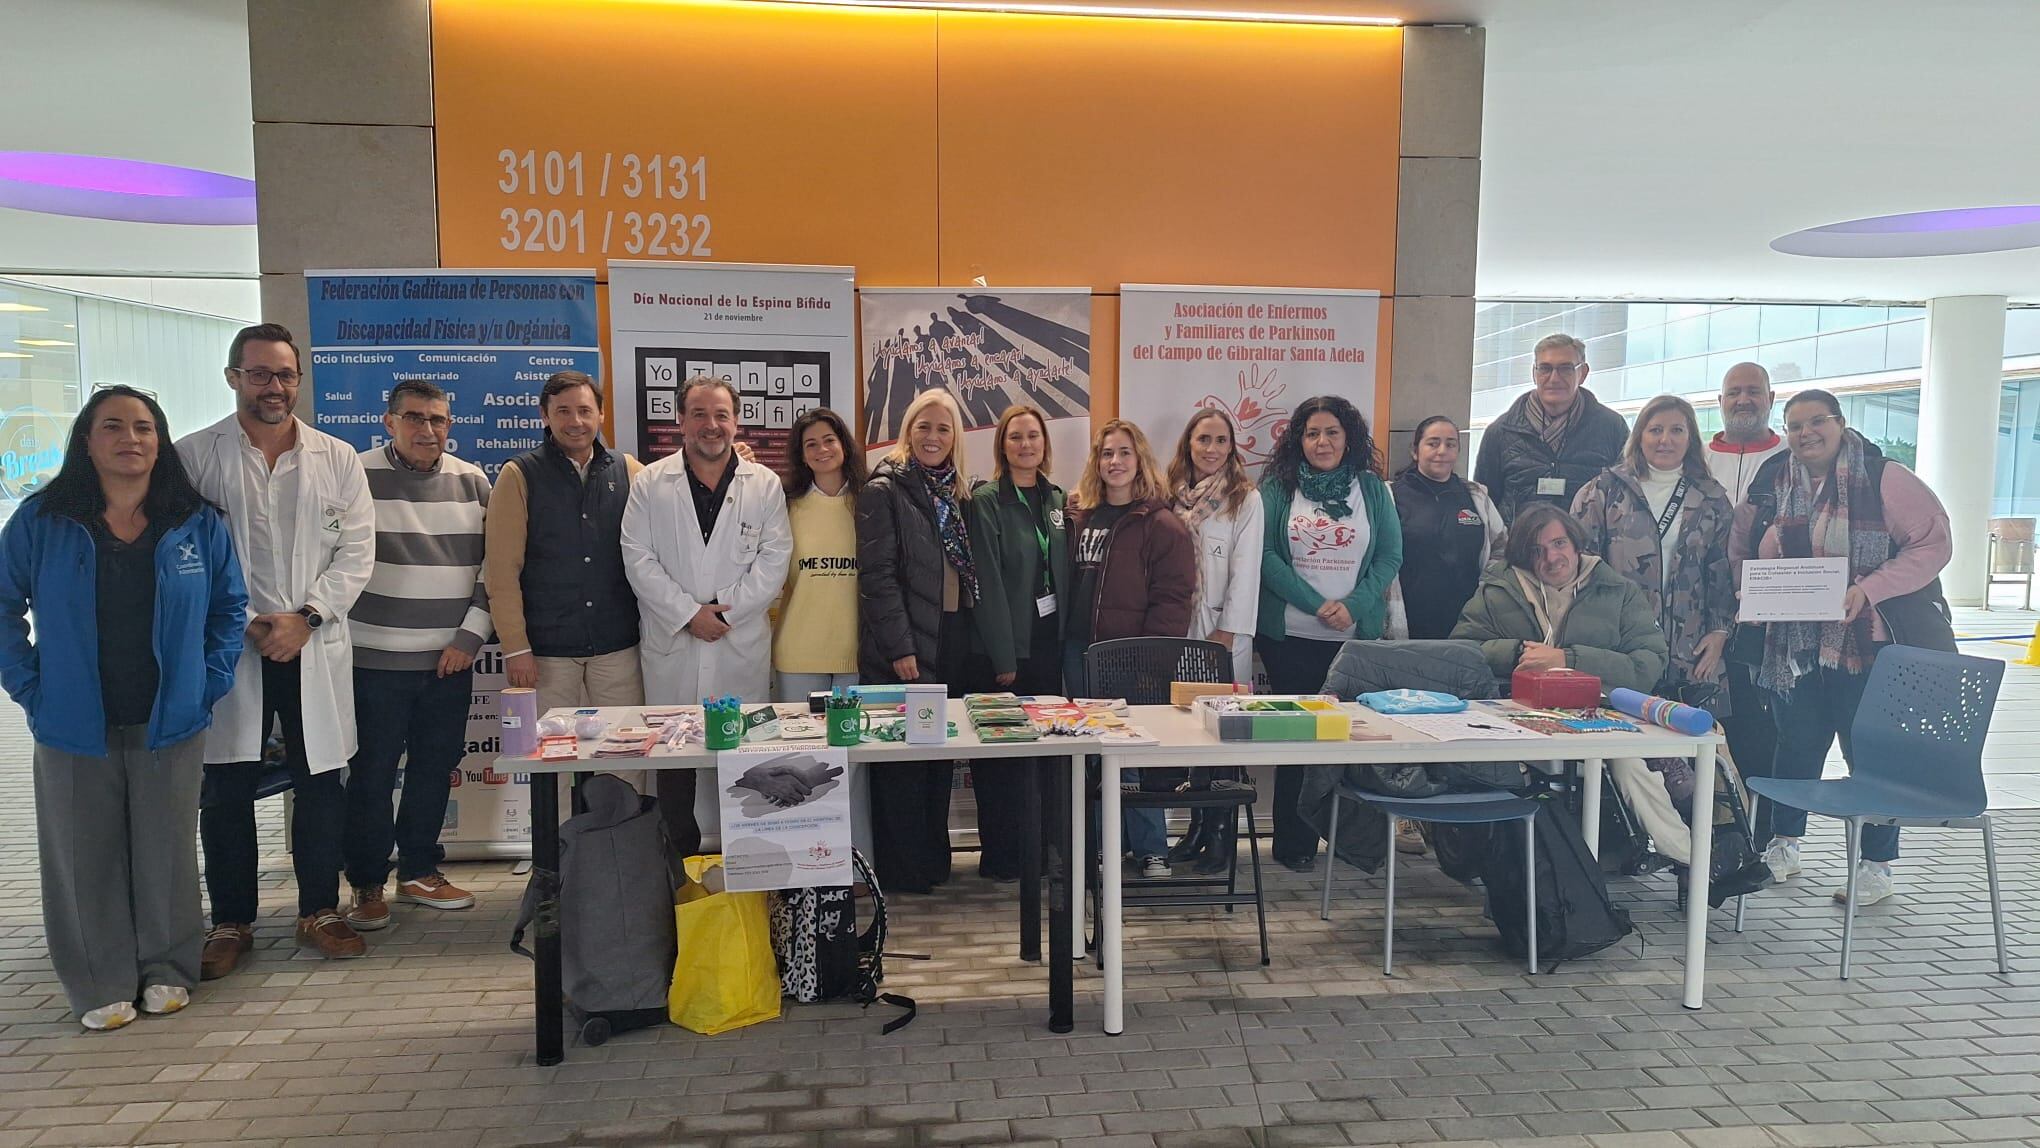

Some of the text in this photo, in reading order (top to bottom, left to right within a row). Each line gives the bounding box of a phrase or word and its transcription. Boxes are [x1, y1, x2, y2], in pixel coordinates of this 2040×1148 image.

[498, 149, 706, 200] 3101 / 3131
[500, 208, 712, 256] 3201 / 3232
[321, 277, 585, 300] Federación Gaditana de Personas con
[634, 292, 831, 310] Día Nacional de la Espina Bífida
[704, 312, 764, 322] 21 de noviembre
[1174, 302, 1328, 320] Asociación de Enfermos
[337, 317, 571, 345] Discapacidad Física y/u Orgánica
[1165, 324, 1335, 341] y Familiares de Parkinson
[313, 353, 394, 364] Ocio Inclusivo
[418, 352, 496, 362] Comunicación
[528, 356, 574, 366] Centros
[1133, 344, 1364, 363] del Campo de Gibraltar Santa Adela
[393, 372, 460, 380] Voluntariado
[514, 372, 551, 380] Asiste
[650, 364, 672, 381] Yo
[325, 392, 352, 400] Salud
[484, 392, 540, 406] Asocia
[496, 416, 545, 428] miem
[1077, 528, 1110, 562] RIZ
